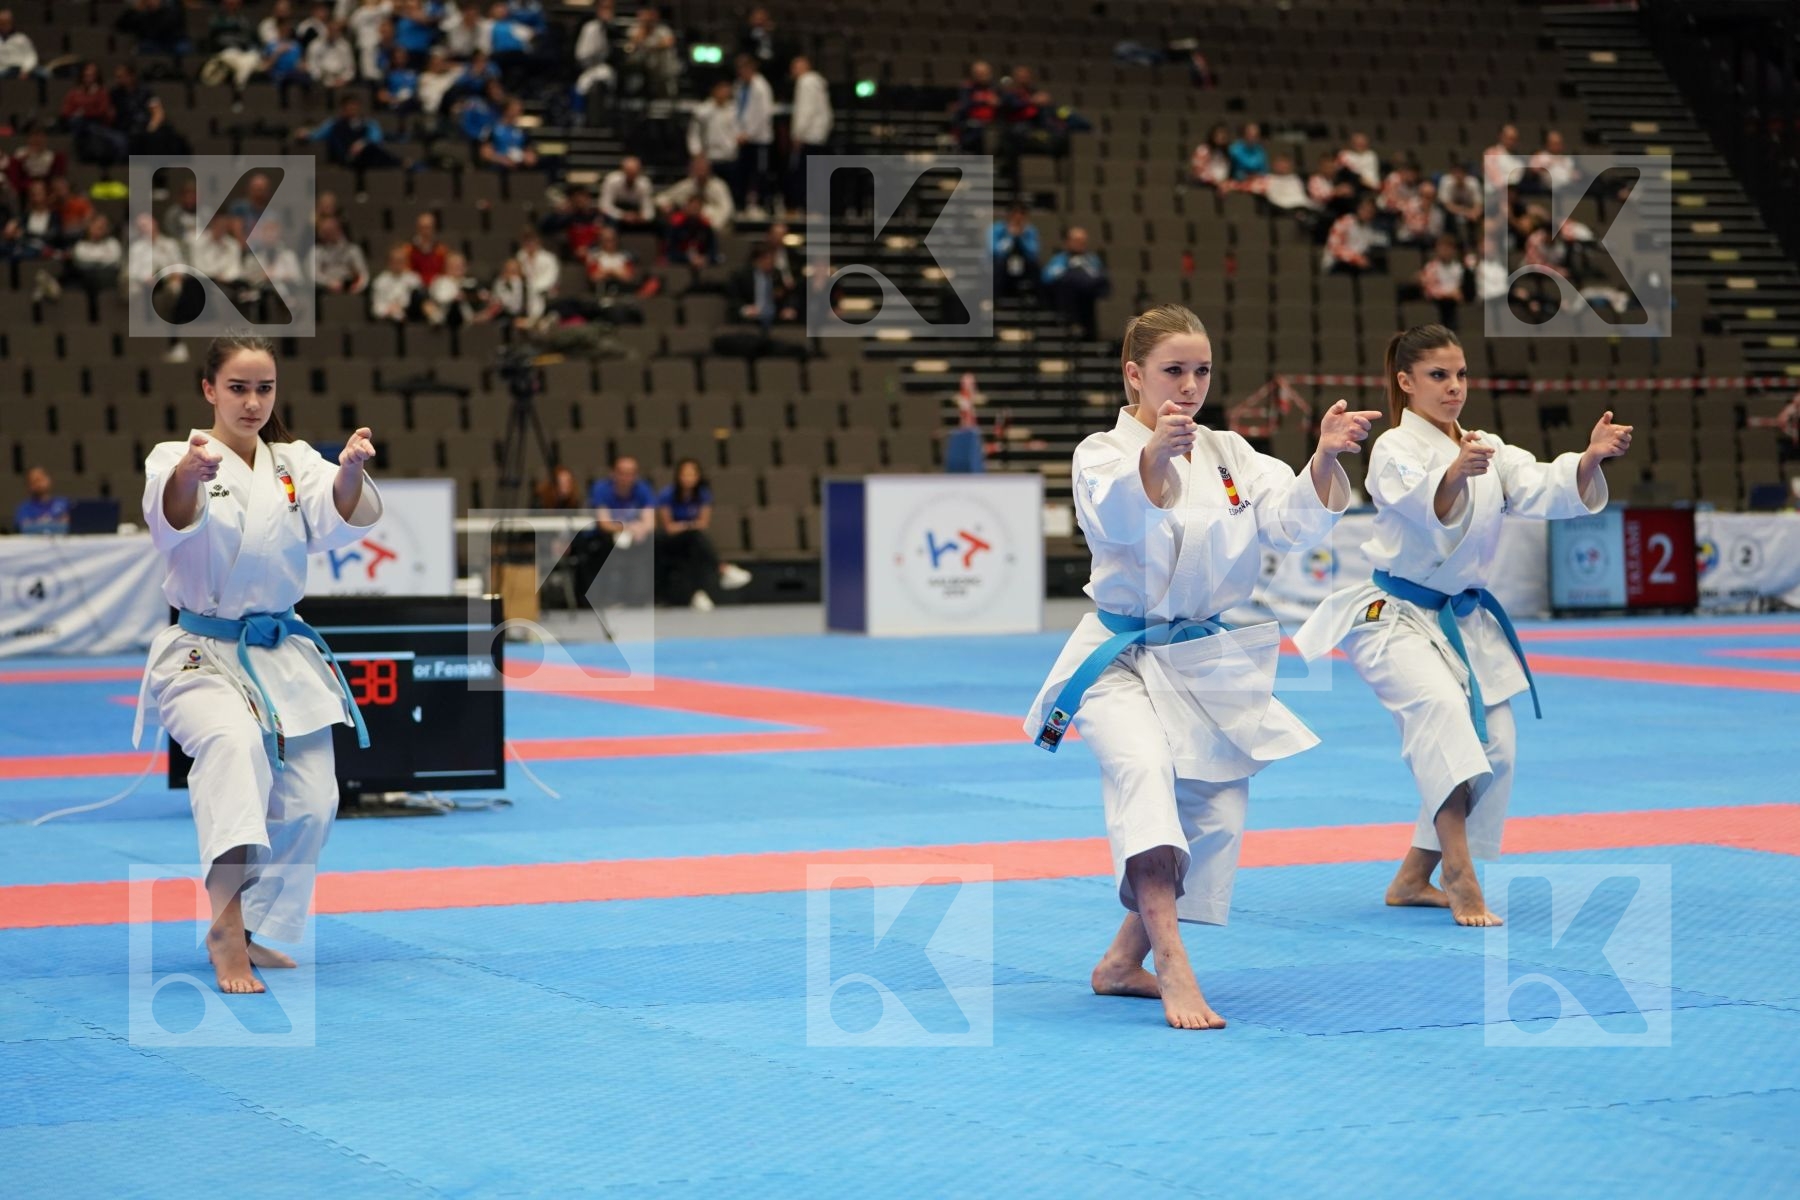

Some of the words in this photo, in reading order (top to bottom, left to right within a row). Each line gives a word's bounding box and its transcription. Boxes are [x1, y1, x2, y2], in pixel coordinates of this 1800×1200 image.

[1647, 532, 1677, 584] 2
[349, 658, 398, 705] 38
[434, 659, 491, 677] Female
